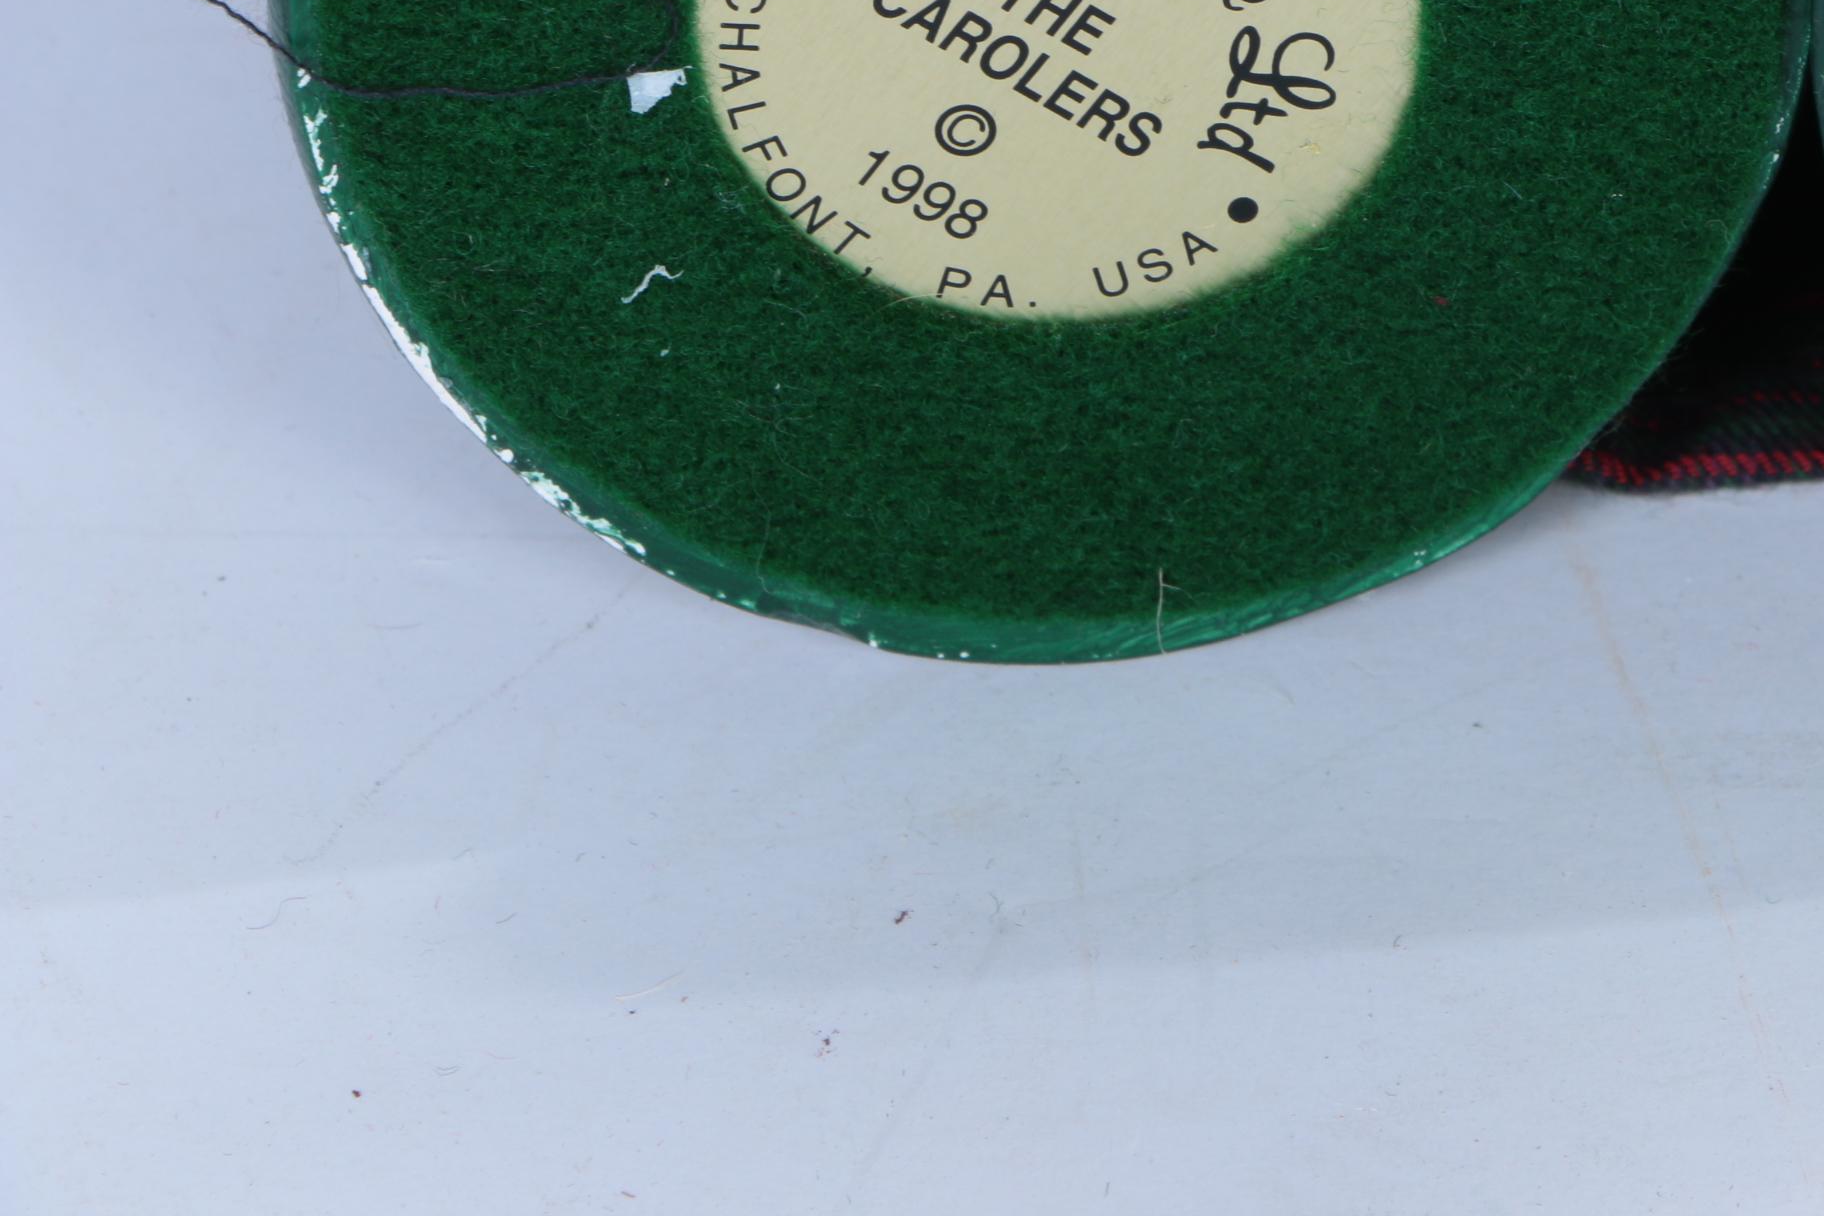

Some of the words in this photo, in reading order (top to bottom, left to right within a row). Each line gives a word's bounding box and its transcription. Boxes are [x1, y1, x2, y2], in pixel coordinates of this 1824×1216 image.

[1197, 24, 1337, 173] Ltd
[857, 149, 989, 239] 1998
[935, 266, 1038, 309] PA.
[1092, 230, 1219, 298] USA
